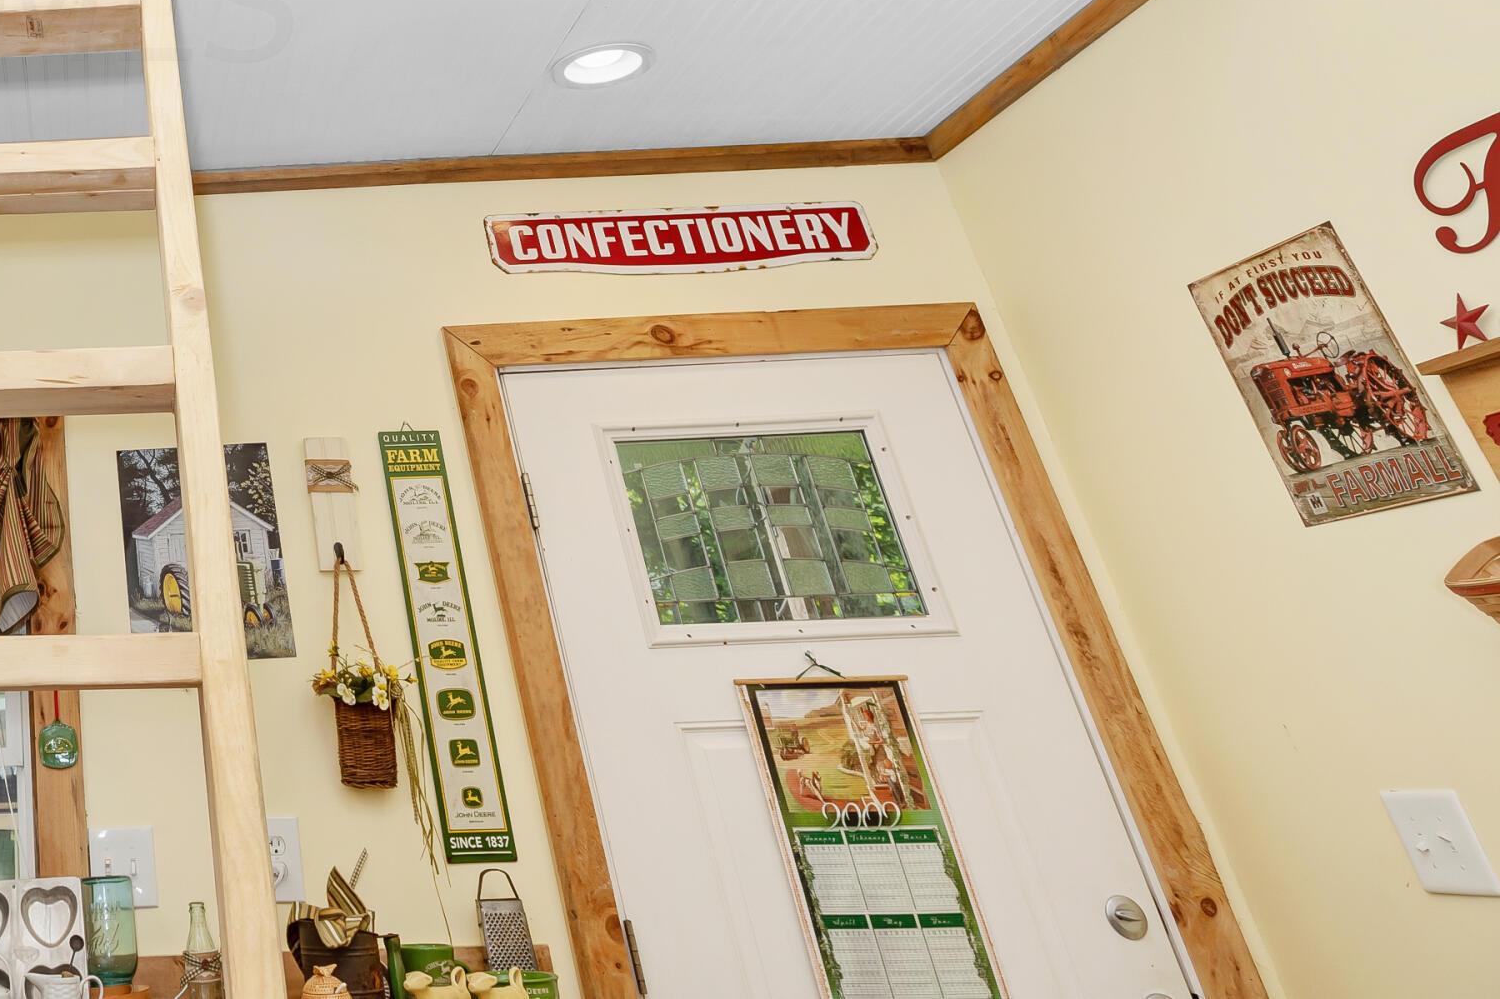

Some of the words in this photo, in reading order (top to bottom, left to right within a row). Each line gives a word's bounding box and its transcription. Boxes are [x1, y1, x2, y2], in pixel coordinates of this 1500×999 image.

[508, 212, 853, 261] CONFECTIONERY
[1214, 290, 1225, 304] IF
[1228, 276, 1241, 290] AT
[1246, 256, 1284, 278] FIRST
[1292, 251, 1323, 262] YOU
[1214, 282, 1265, 349] DON'T
[1256, 265, 1357, 310] SUCCEED
[383, 434, 435, 442] QUALITY
[386, 448, 440, 463] FARM
[388, 463, 441, 472] EQUIPMENT
[1325, 444, 1463, 508] FARMALL
[455, 811, 473, 819] JOHN
[473, 810, 496, 819] DEERE
[449, 837, 483, 850] SINCE
[485, 835, 510, 848] 1837
